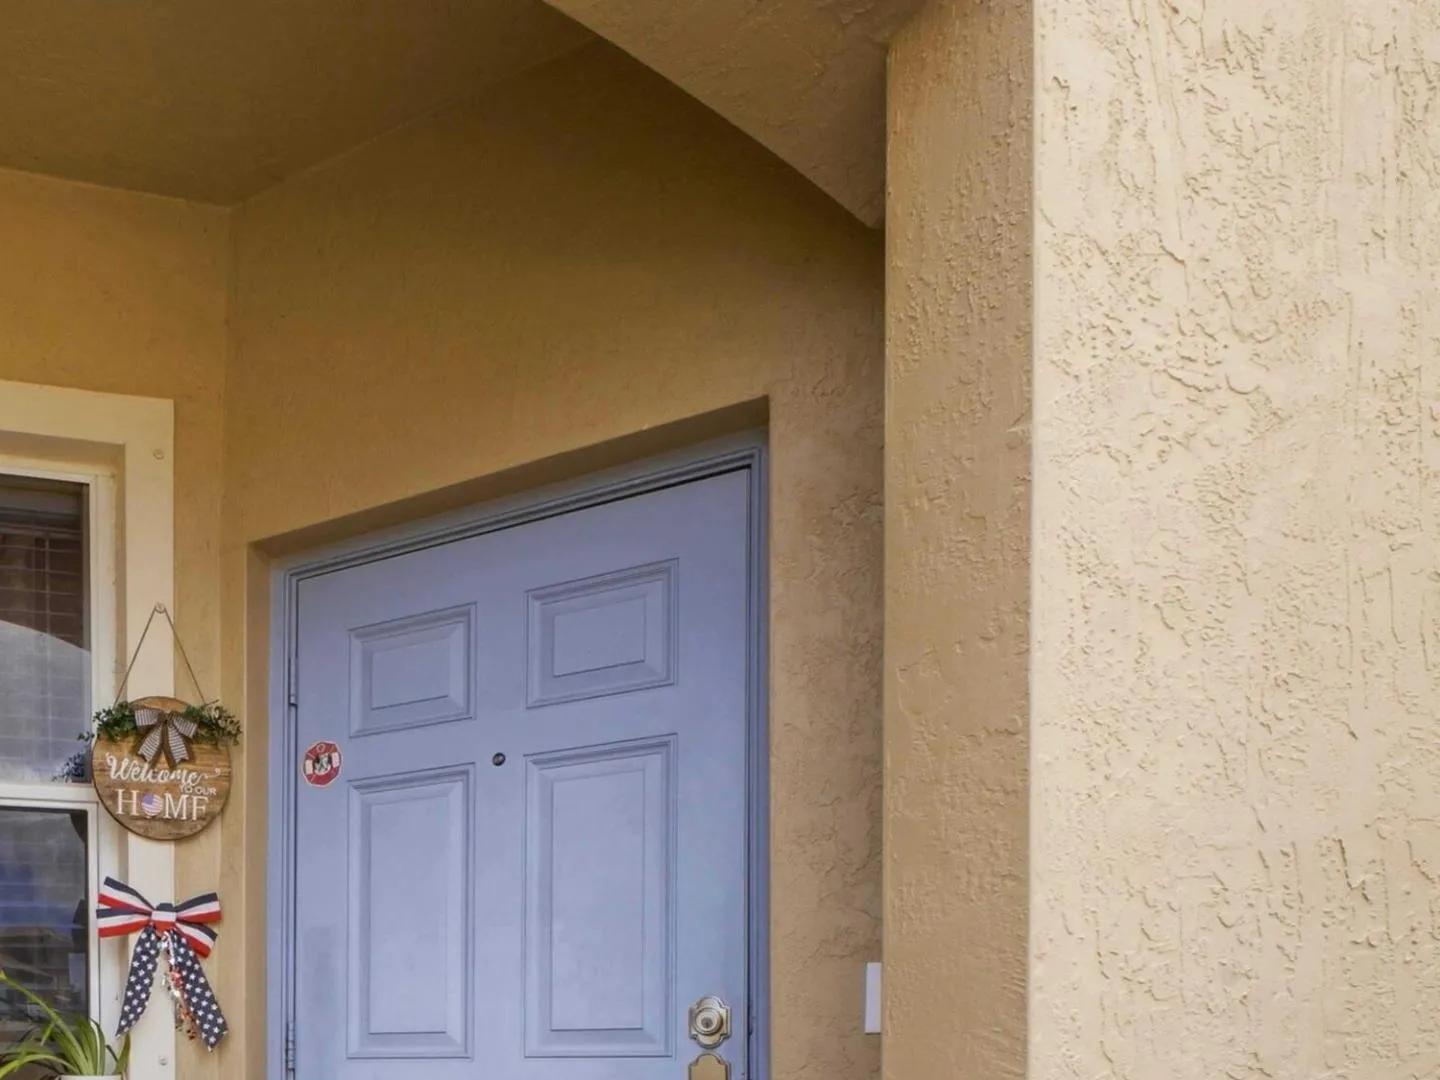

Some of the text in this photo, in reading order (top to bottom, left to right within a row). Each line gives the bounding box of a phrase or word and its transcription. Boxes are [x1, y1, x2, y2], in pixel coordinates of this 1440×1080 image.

[105, 752, 220, 786] Welcome
[115, 788, 209, 820] HOME
[194, 786, 217, 796] OUR
